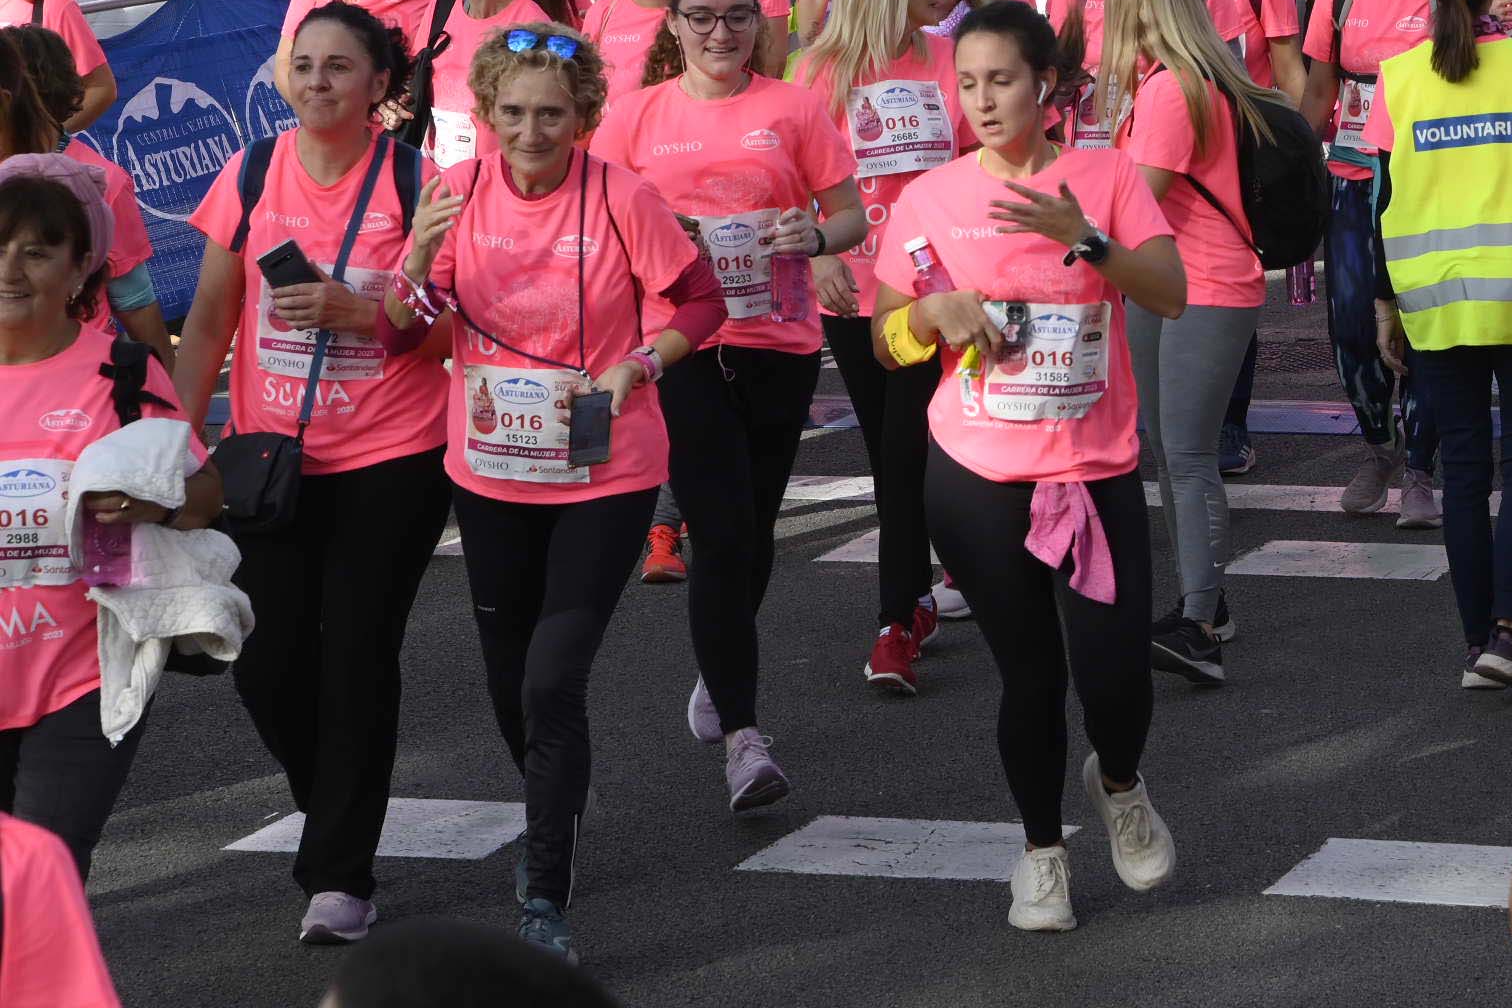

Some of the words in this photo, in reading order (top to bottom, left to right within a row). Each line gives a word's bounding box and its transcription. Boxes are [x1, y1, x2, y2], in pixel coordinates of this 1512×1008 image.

[604, 33, 640, 44] OYSHO
[886, 115, 920, 130] 016
[891, 132, 919, 143] 26685
[653, 141, 703, 156] OYSHO
[866, 146, 895, 156] CARRERA
[125, 133, 235, 193] ASTURIANA
[867, 161, 898, 170] OYSHO
[717, 254, 753, 271] 016
[722, 274, 752, 285] 29233
[271, 342, 306, 352] CARRERA
[267, 355, 305, 370] OYSHO
[1031, 350, 1073, 368] 016
[1035, 372, 1070, 383] 31585
[263, 376, 350, 407] SUMA
[500, 386, 545, 399] ASTURIANA
[997, 401, 1037, 412] OYSHO
[500, 412, 543, 431] 016
[505, 433, 538, 446] 15123
[477, 442, 507, 453] CARRERA
[474, 456, 509, 471] OYSHO
[0, 507, 49, 528] 016
[6, 532, 39, 544] 2988
[20, 548, 33, 557] LA
